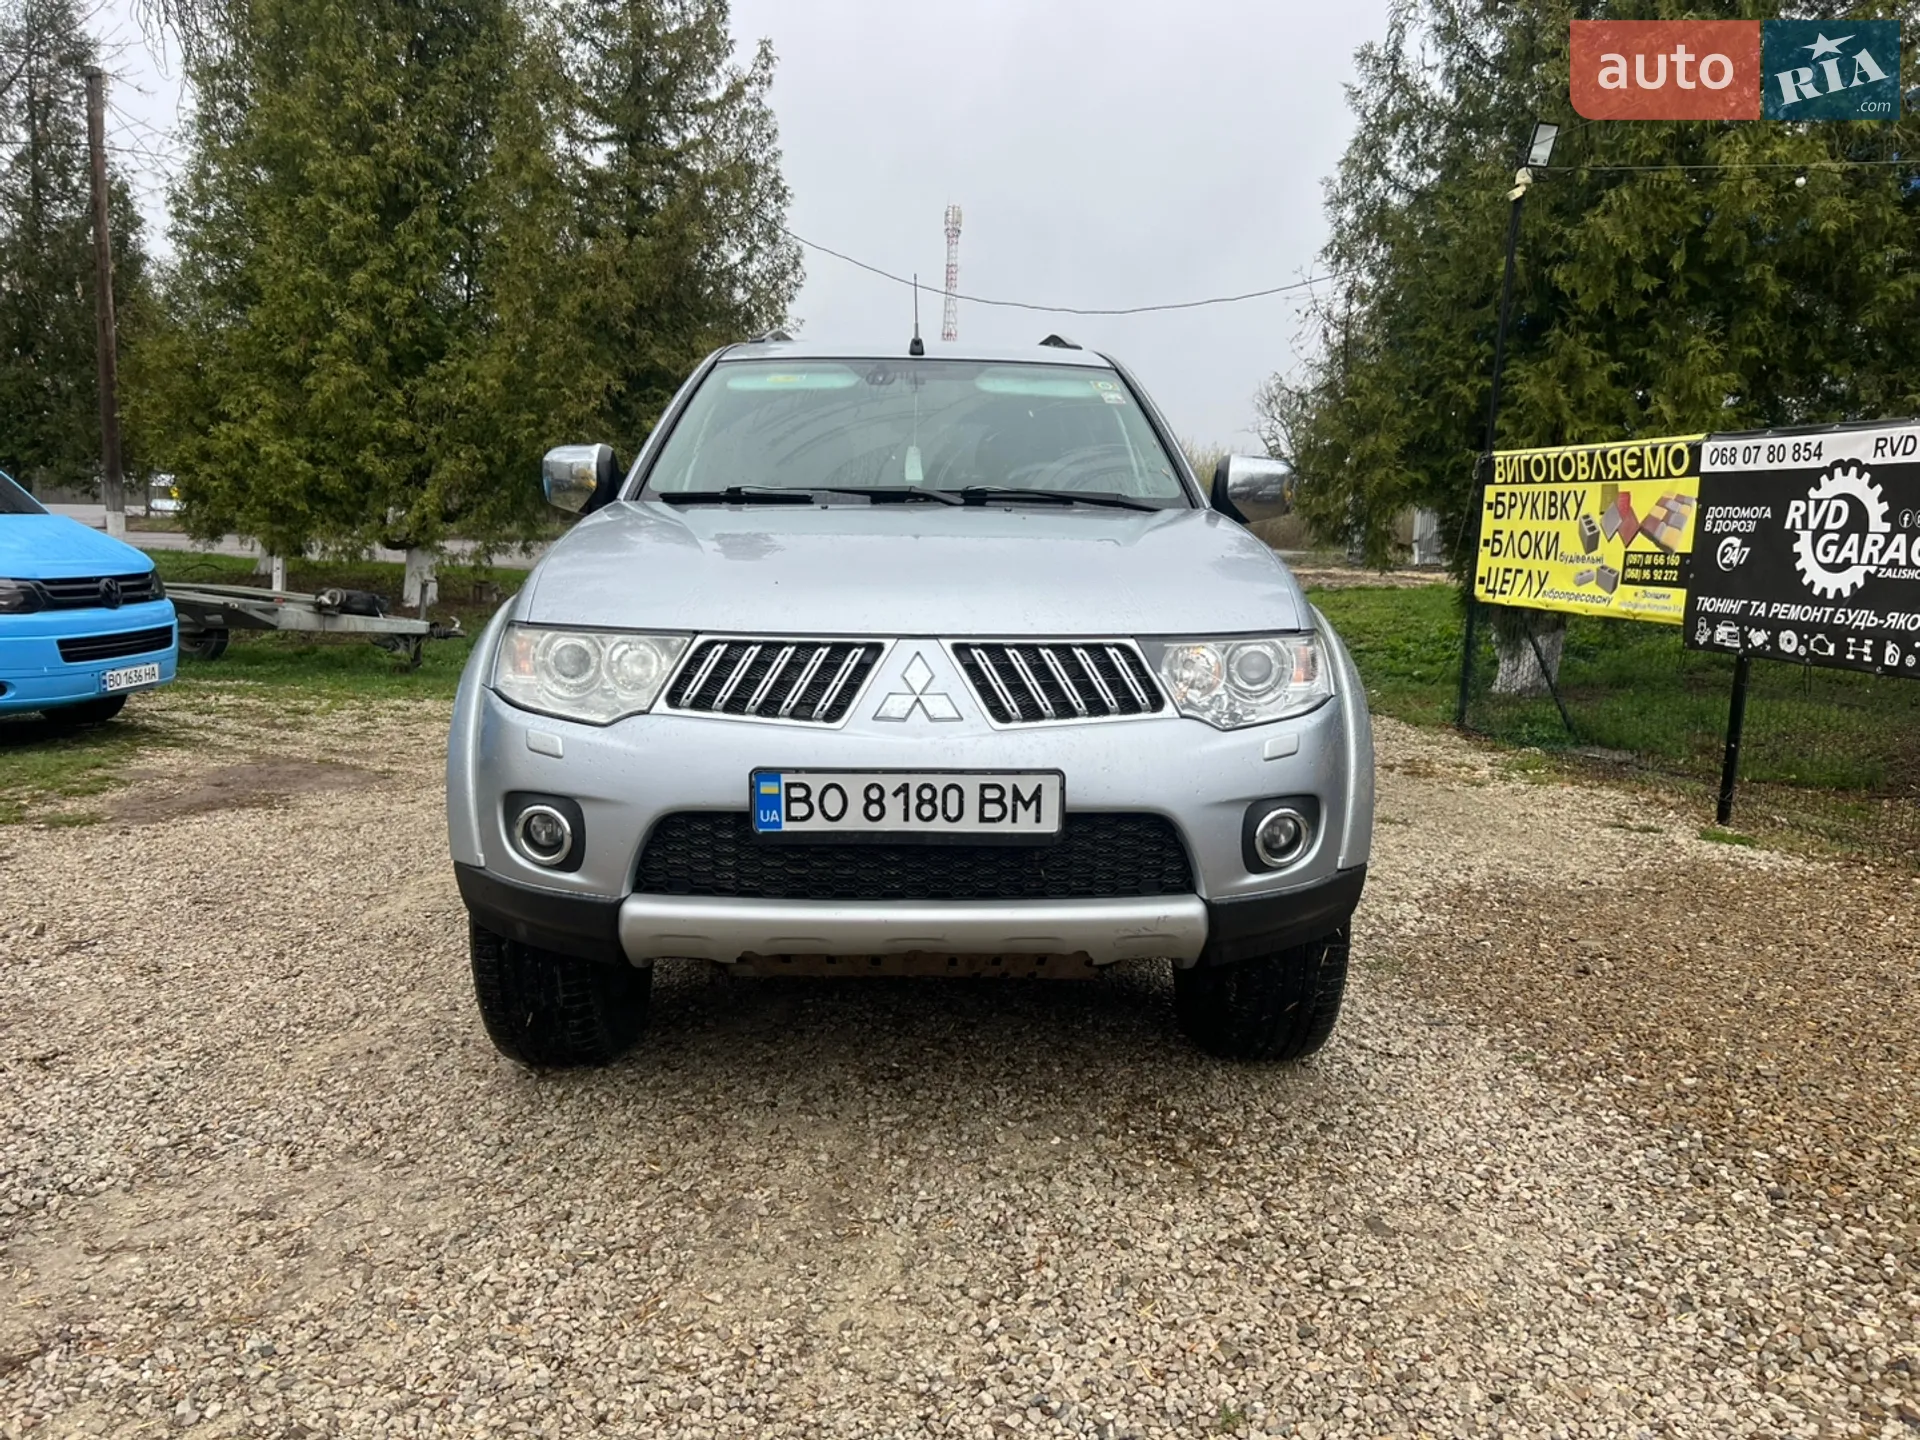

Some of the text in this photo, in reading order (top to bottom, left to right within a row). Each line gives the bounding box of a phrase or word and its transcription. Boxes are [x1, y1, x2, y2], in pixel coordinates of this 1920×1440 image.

[1709, 441, 1823, 466] 068 07 80 854
[1873, 434, 1918, 458] RVD
[1494, 442, 1690, 483] ВИГОТОВЛЯЄМО
[1493, 490, 1587, 521] БРУКІВКУ
[1705, 506, 1772, 520] ДОПОМОГА
[1784, 499, 1850, 531] RVD
[1704, 520, 1757, 534] В ДОРОЗІ
[1490, 529, 1560, 562] БЛОКИ
[1721, 546, 1751, 567] 24/7
[1484, 566, 1550, 599] ЦЕГЛУ
[1696, 596, 1748, 615] ТЮНІНГ
[1749, 601, 1766, 618] ТА
[1768, 603, 1835, 623] РЕМОНТ
[108, 666, 157, 688] BO 1636 HA
[784, 782, 1042, 824] BO 8180 BM
[760, 810, 780, 823] UA
